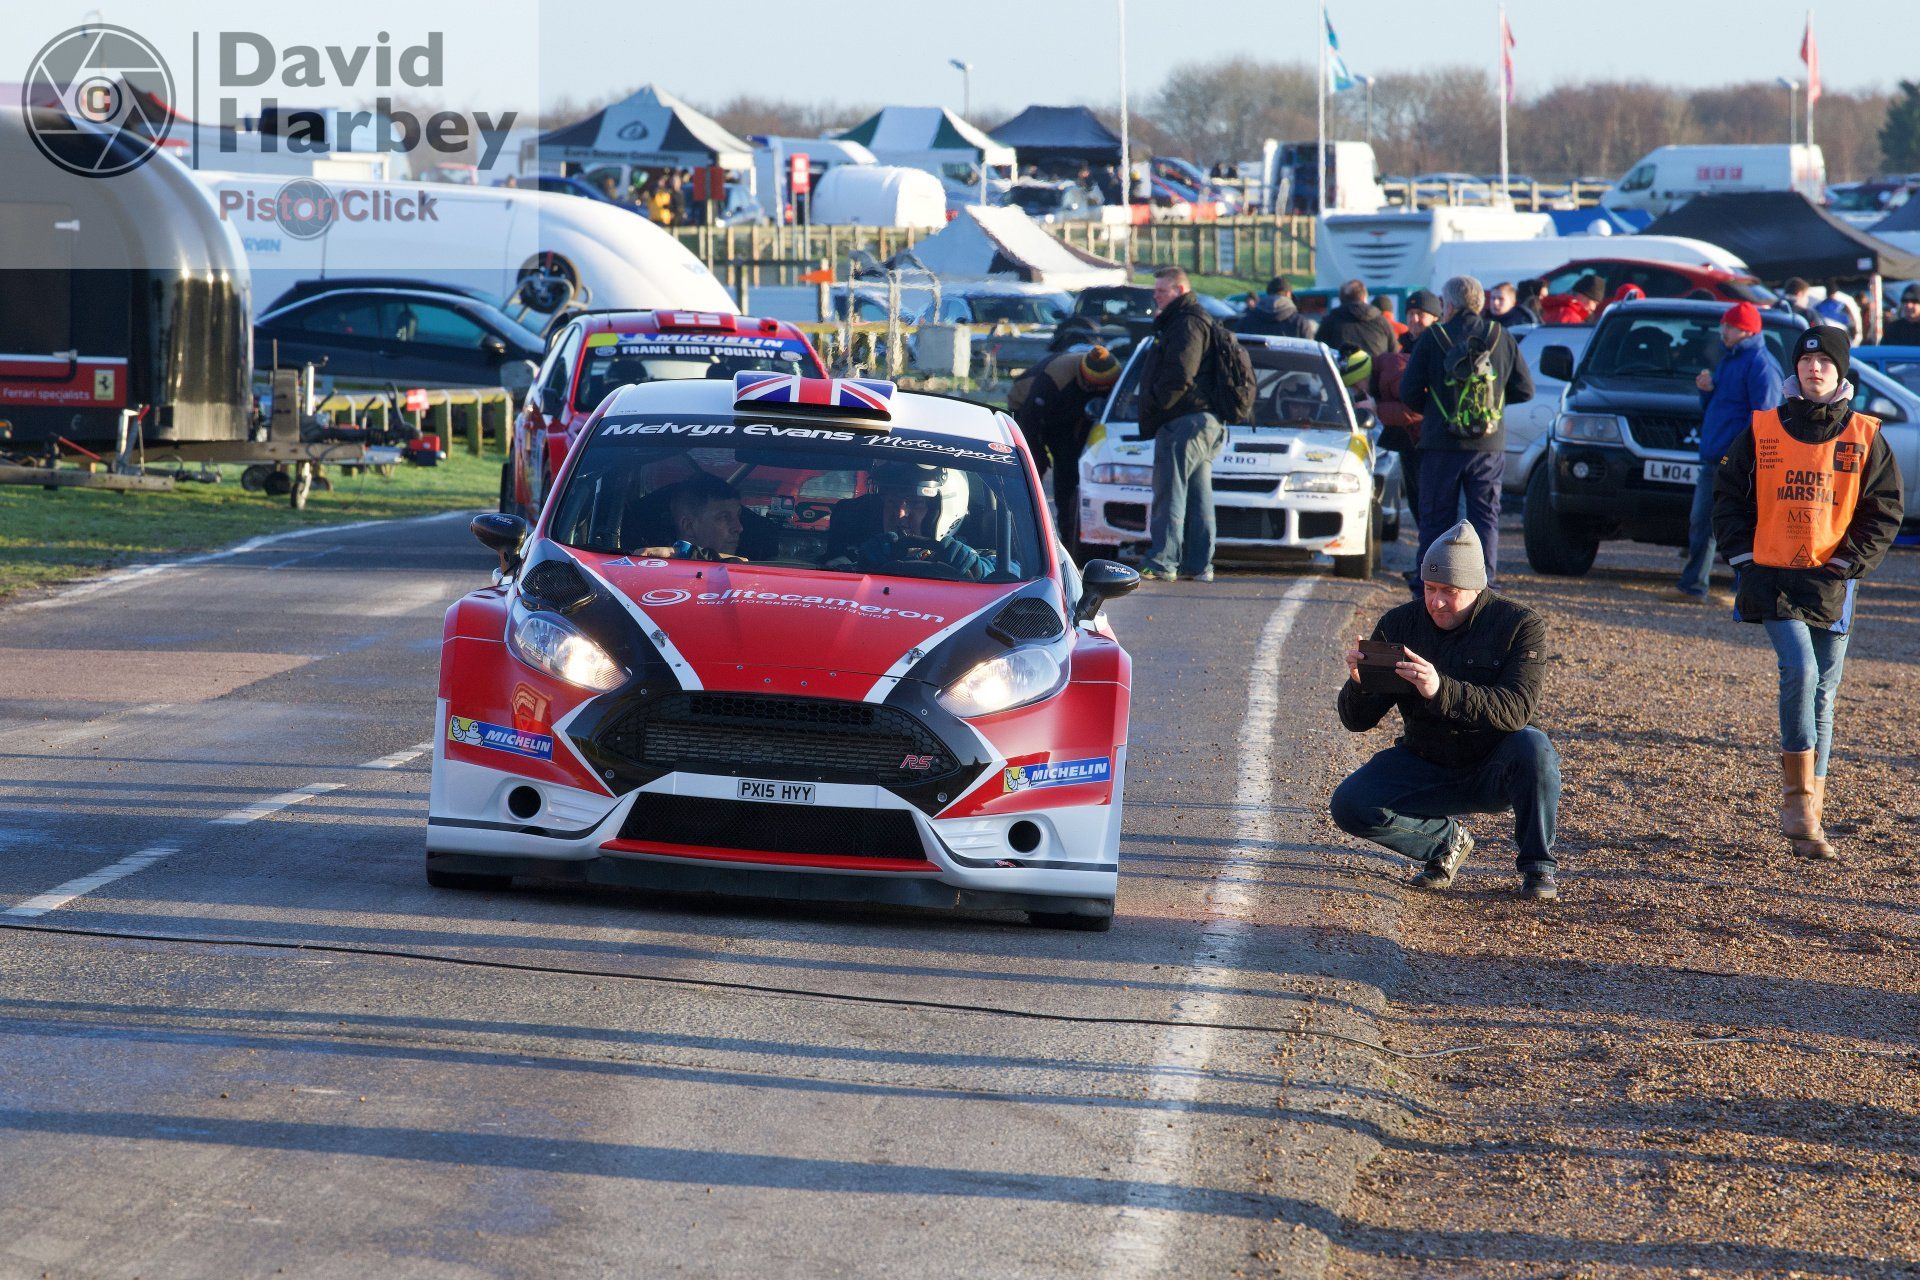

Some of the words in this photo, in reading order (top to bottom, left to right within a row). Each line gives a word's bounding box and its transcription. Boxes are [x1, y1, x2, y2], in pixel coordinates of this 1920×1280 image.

[655, 334, 785, 348] MICHELIN
[621, 345, 671, 355] FRANK
[675, 345, 710, 356] BIRD
[714, 347, 777, 359] POULTRY
[600, 422, 737, 437] Melvyn
[742, 424, 856, 441] Evans
[864, 434, 1016, 463] Motorsport
[1785, 469, 1833, 486] CADET
[1777, 486, 1839, 506] MARSHAL
[697, 589, 945, 623] elitecameron
[485, 730, 551, 752] MICHELIN
[899, 754, 934, 770] RS
[1032, 762, 1107, 781] MICHELIN
[741, 781, 775, 799] PX15
[781, 784, 812, 801] HYY
